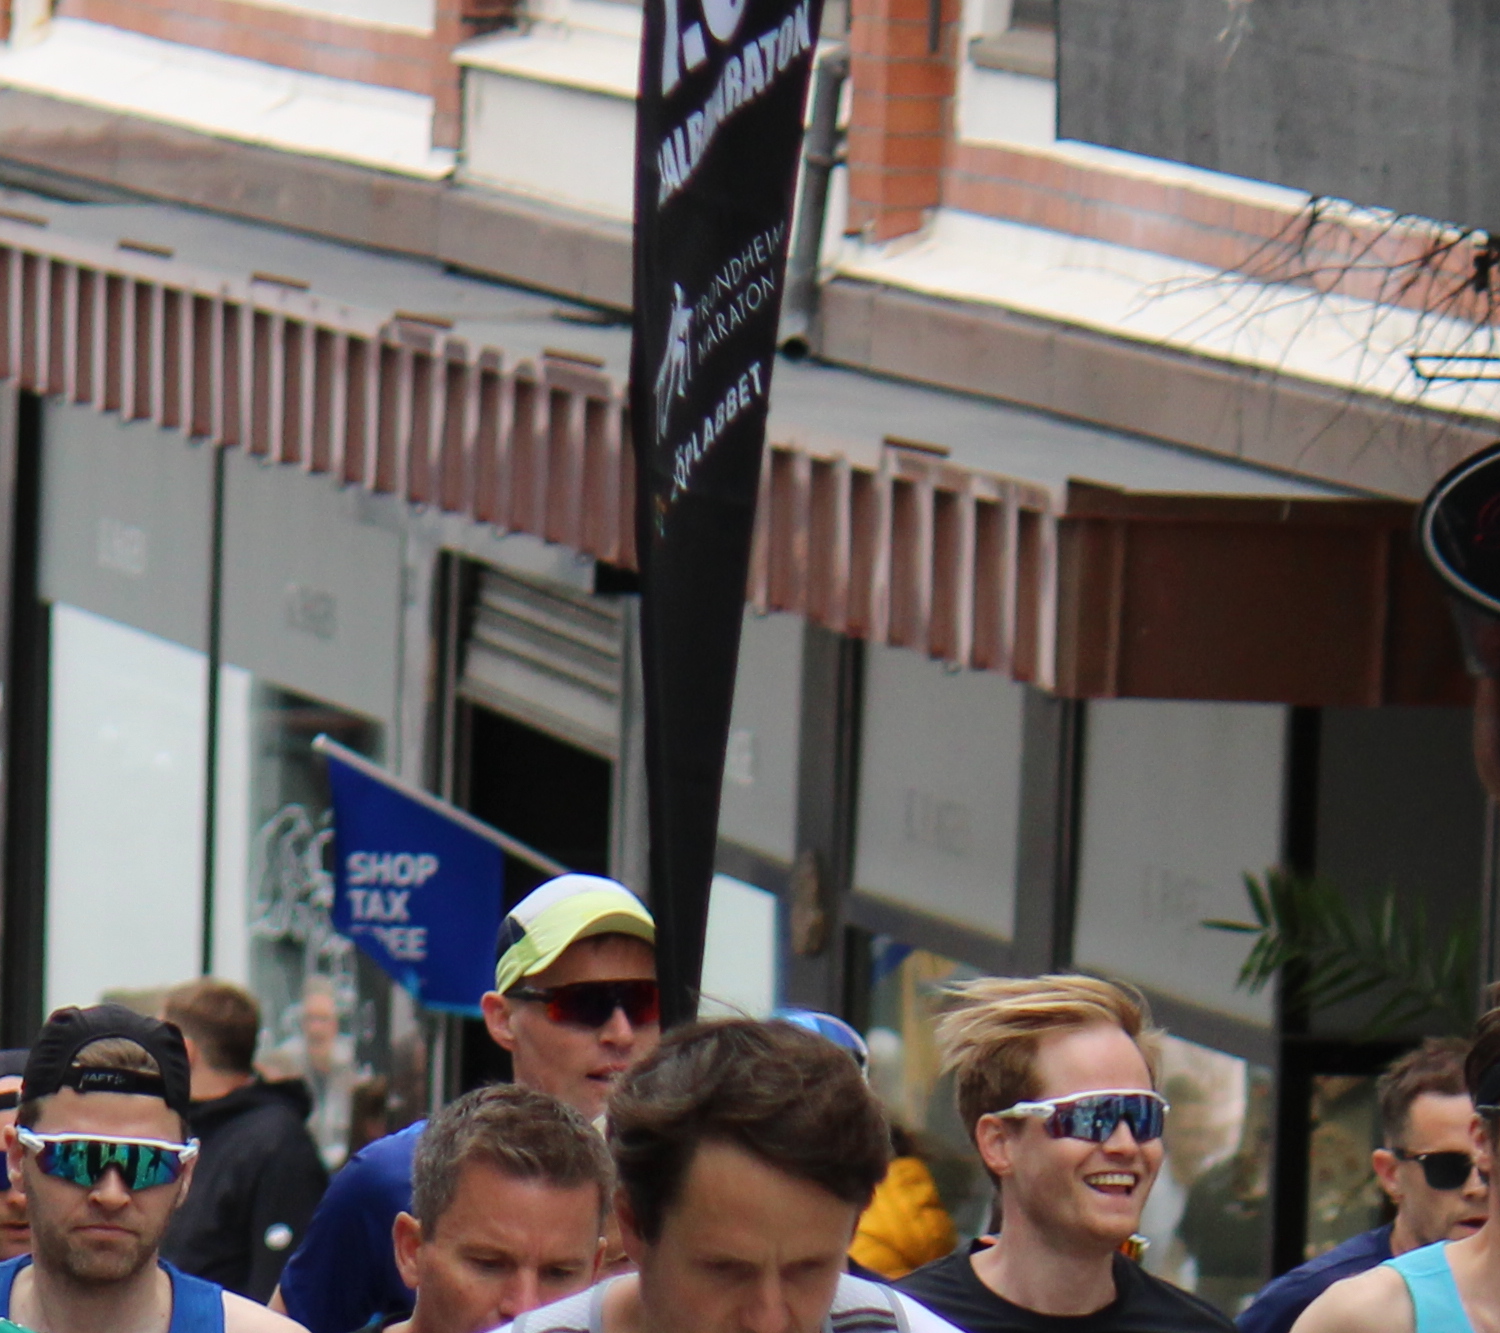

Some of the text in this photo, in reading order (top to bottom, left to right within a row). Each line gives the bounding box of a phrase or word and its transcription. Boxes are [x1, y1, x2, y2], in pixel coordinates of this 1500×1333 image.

[346, 851, 440, 887] SHOP
[346, 888, 411, 922] TAX
[350, 925, 428, 961] EE
